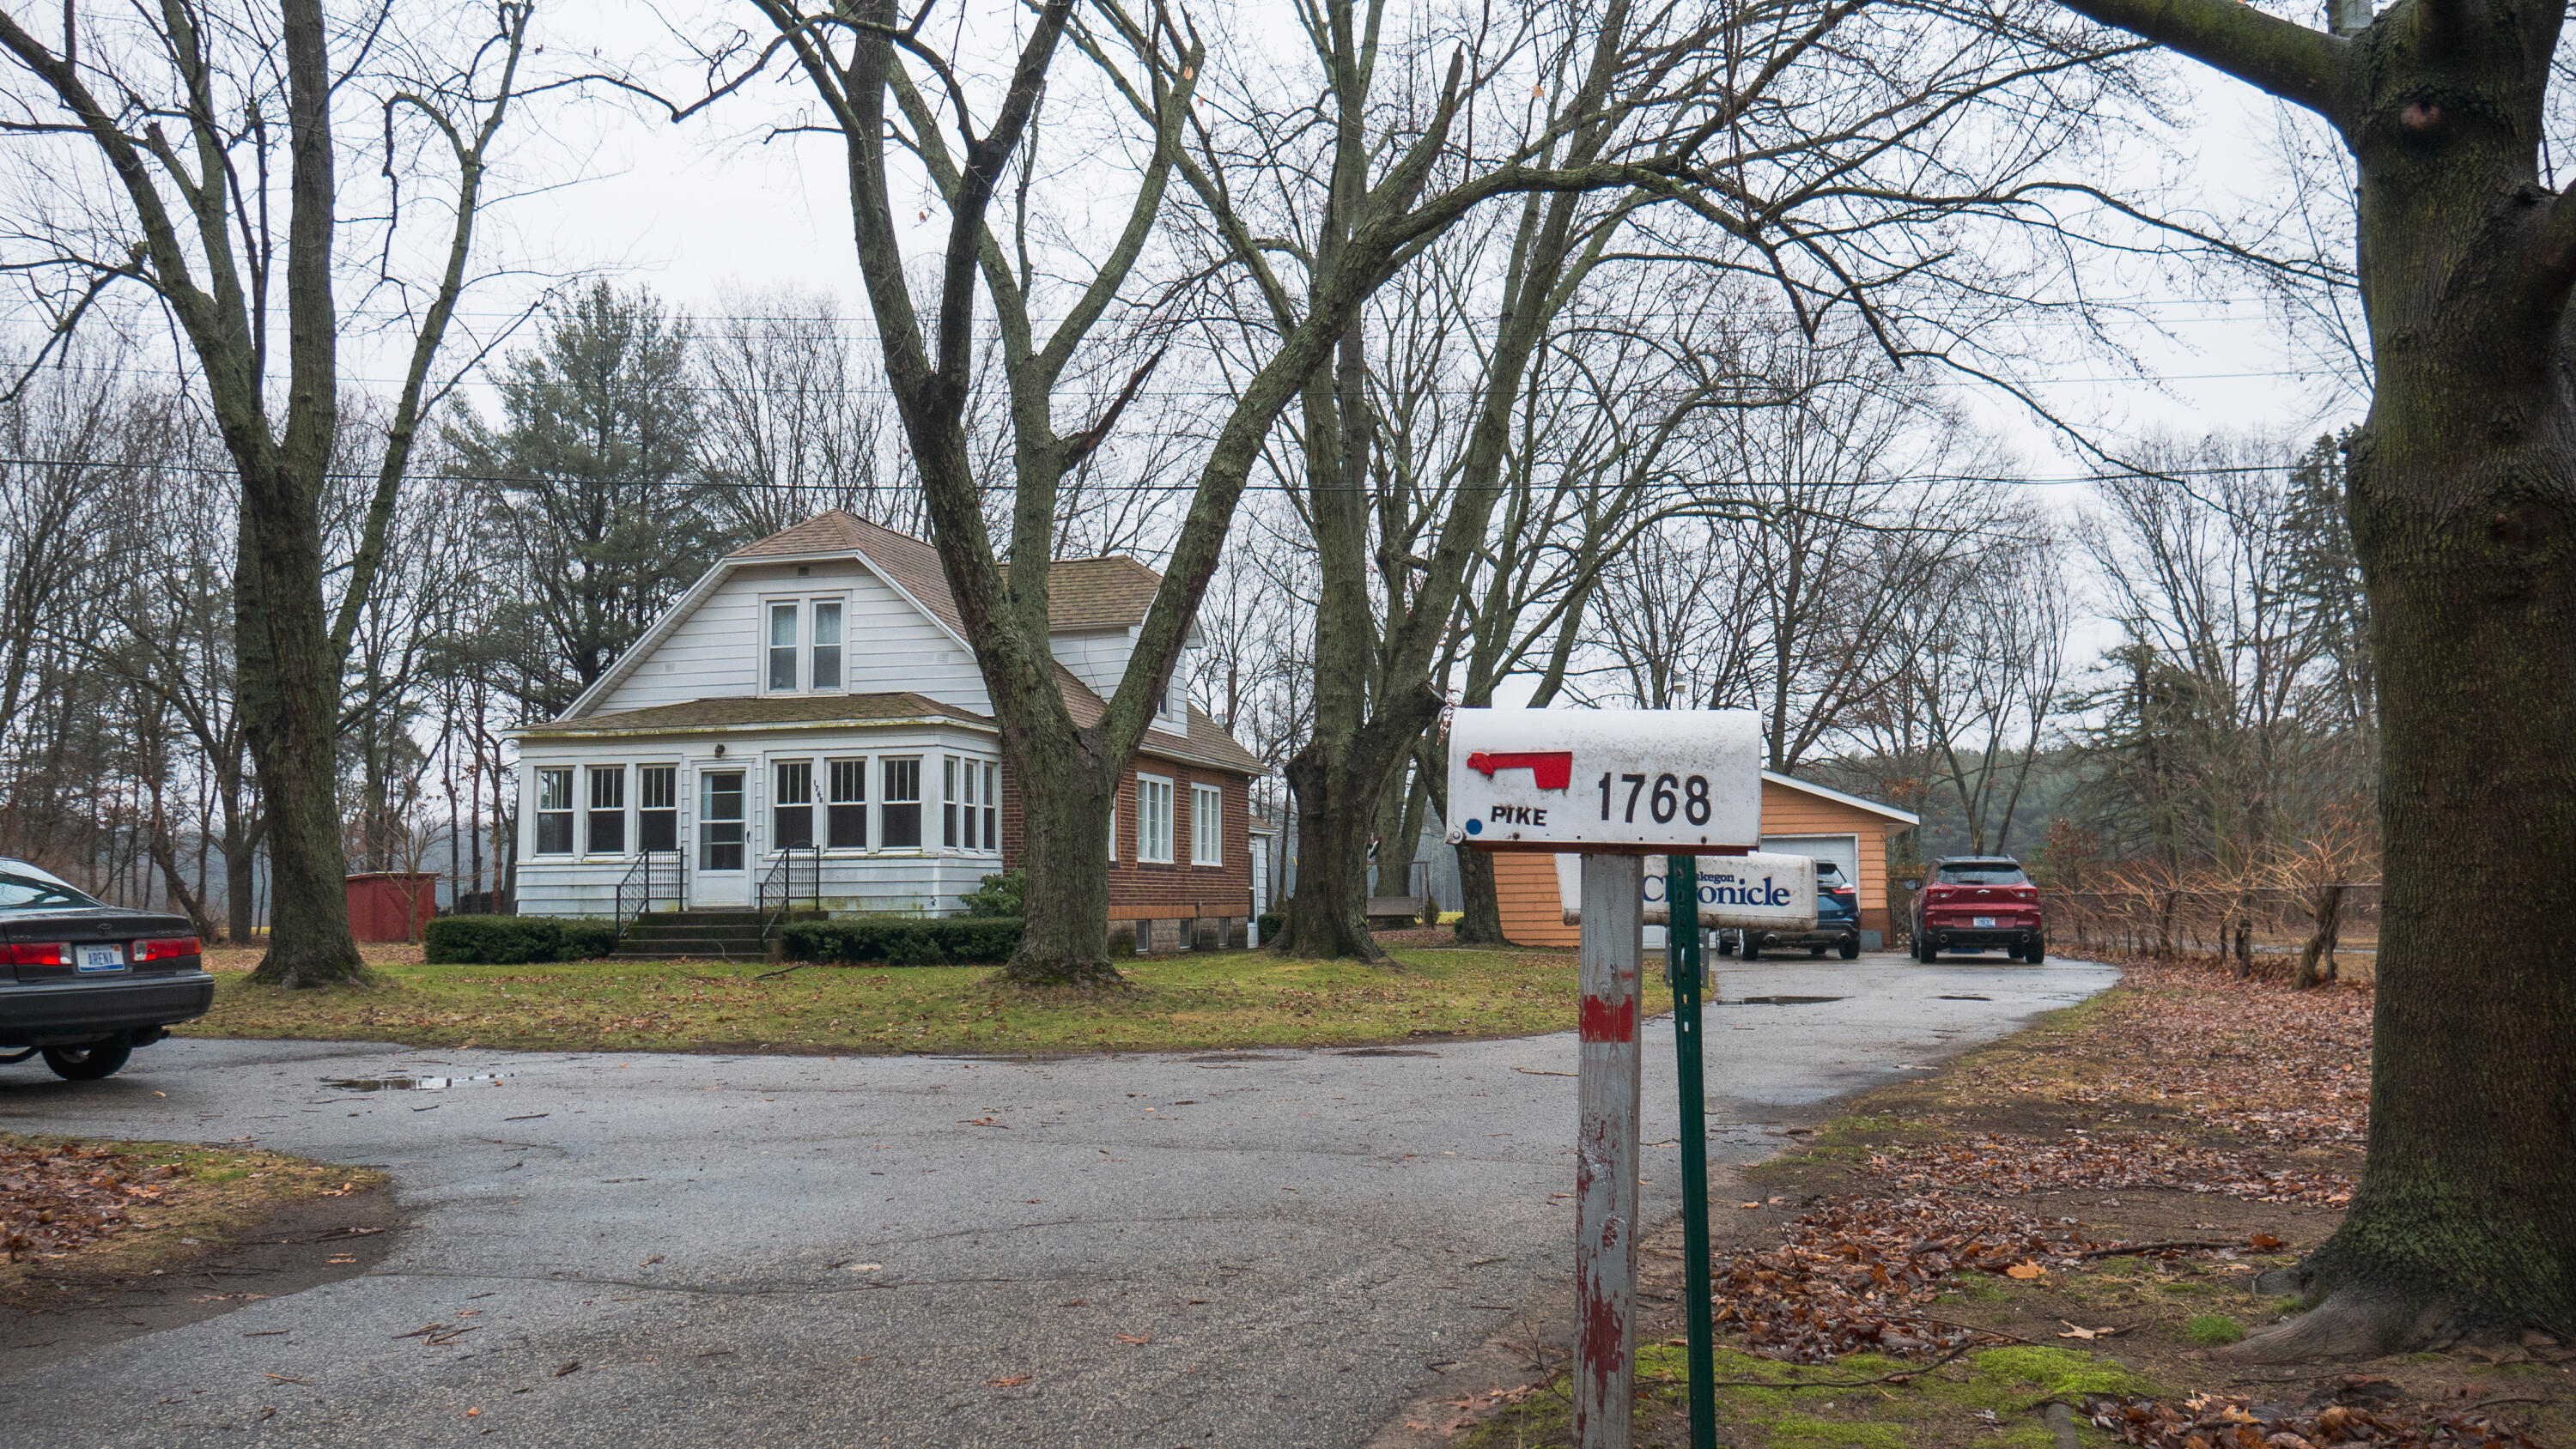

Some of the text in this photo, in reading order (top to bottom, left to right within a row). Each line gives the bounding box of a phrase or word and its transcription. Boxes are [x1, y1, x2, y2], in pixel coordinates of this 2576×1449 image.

[813, 779, 823, 803] 1768
[1598, 772, 1711, 827] 1768
[1490, 805, 1548, 827] PIKE
